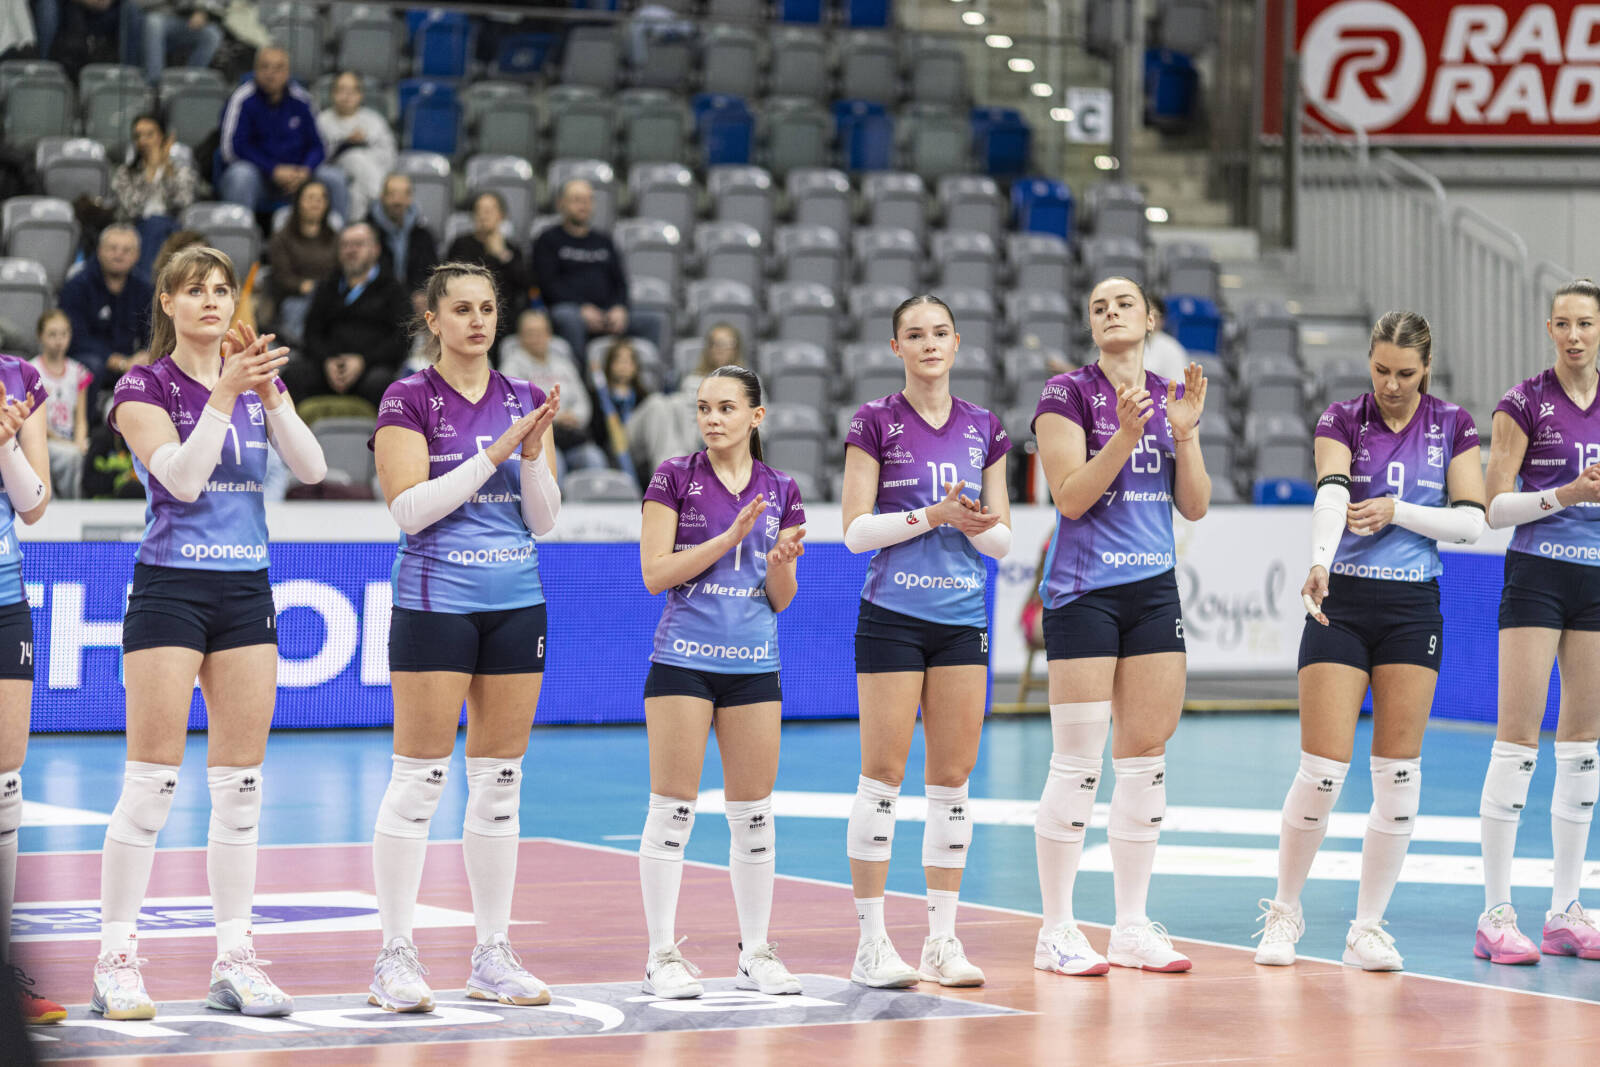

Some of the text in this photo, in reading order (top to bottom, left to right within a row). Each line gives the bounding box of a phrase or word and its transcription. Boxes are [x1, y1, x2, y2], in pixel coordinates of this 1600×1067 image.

[1078, 104, 1101, 134] C
[1131, 434, 1161, 474] 25
[926, 461, 958, 502] 19
[1386, 461, 1405, 500] 9
[181, 541, 266, 562] oponeo.pl
[448, 541, 533, 566] oponeo.pl
[1101, 549, 1173, 569] oponeo.pl
[1539, 542, 1600, 560] opone
[894, 571, 980, 593] oponeo.pl
[1333, 561, 1425, 583] oponeo.pl
[20, 641, 33, 665] 14
[537, 636, 545, 658] 6
[673, 638, 769, 663] oponeo.pl
[1427, 635, 1437, 655] 9
